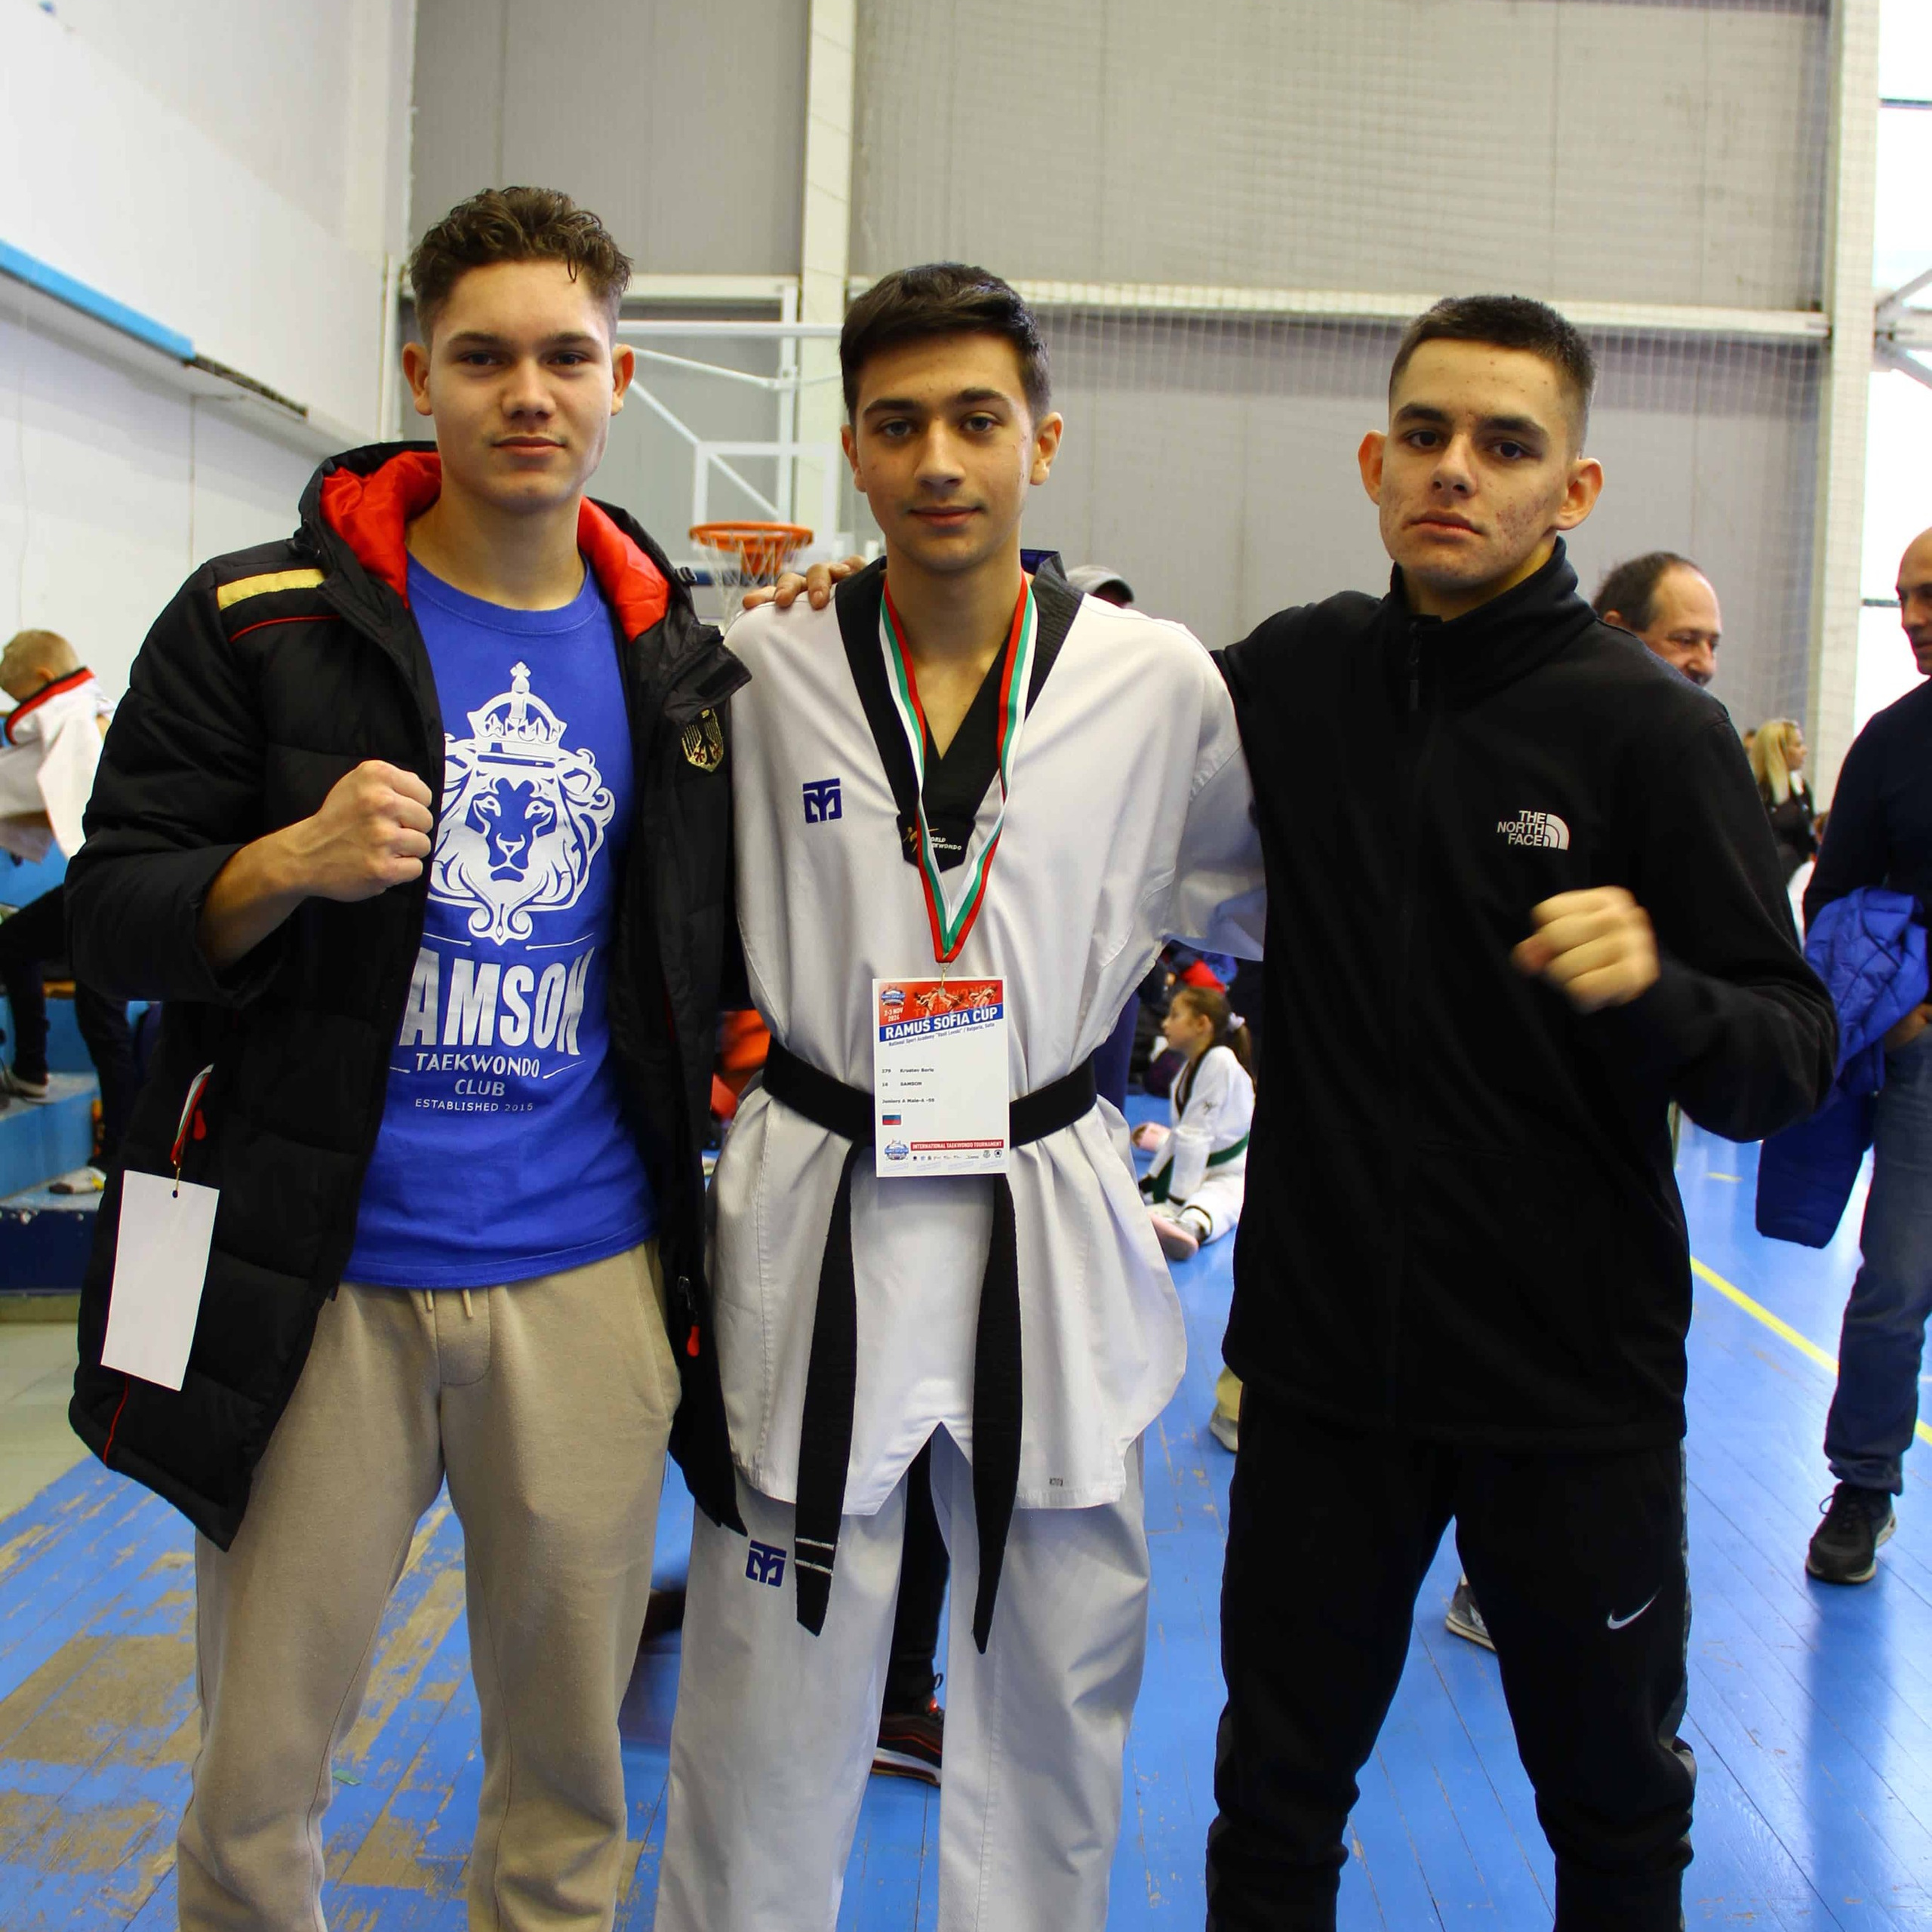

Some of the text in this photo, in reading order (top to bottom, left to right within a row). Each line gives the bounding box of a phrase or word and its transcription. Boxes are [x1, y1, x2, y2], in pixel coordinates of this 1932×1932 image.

[1519, 810, 1546, 824] THE
[1497, 822, 1545, 835] NORTH
[1508, 833, 1543, 846] FACE
[398, 946, 595, 1056] AMSON
[885, 1019, 931, 1039] RAMUS
[933, 1011, 971, 1030] SOFIA
[972, 1006, 998, 1023] CUP
[415, 1052, 540, 1078] TAEKWONDO
[454, 1078, 506, 1097] CLUB
[415, 1098, 499, 1112] ESTABLISHED
